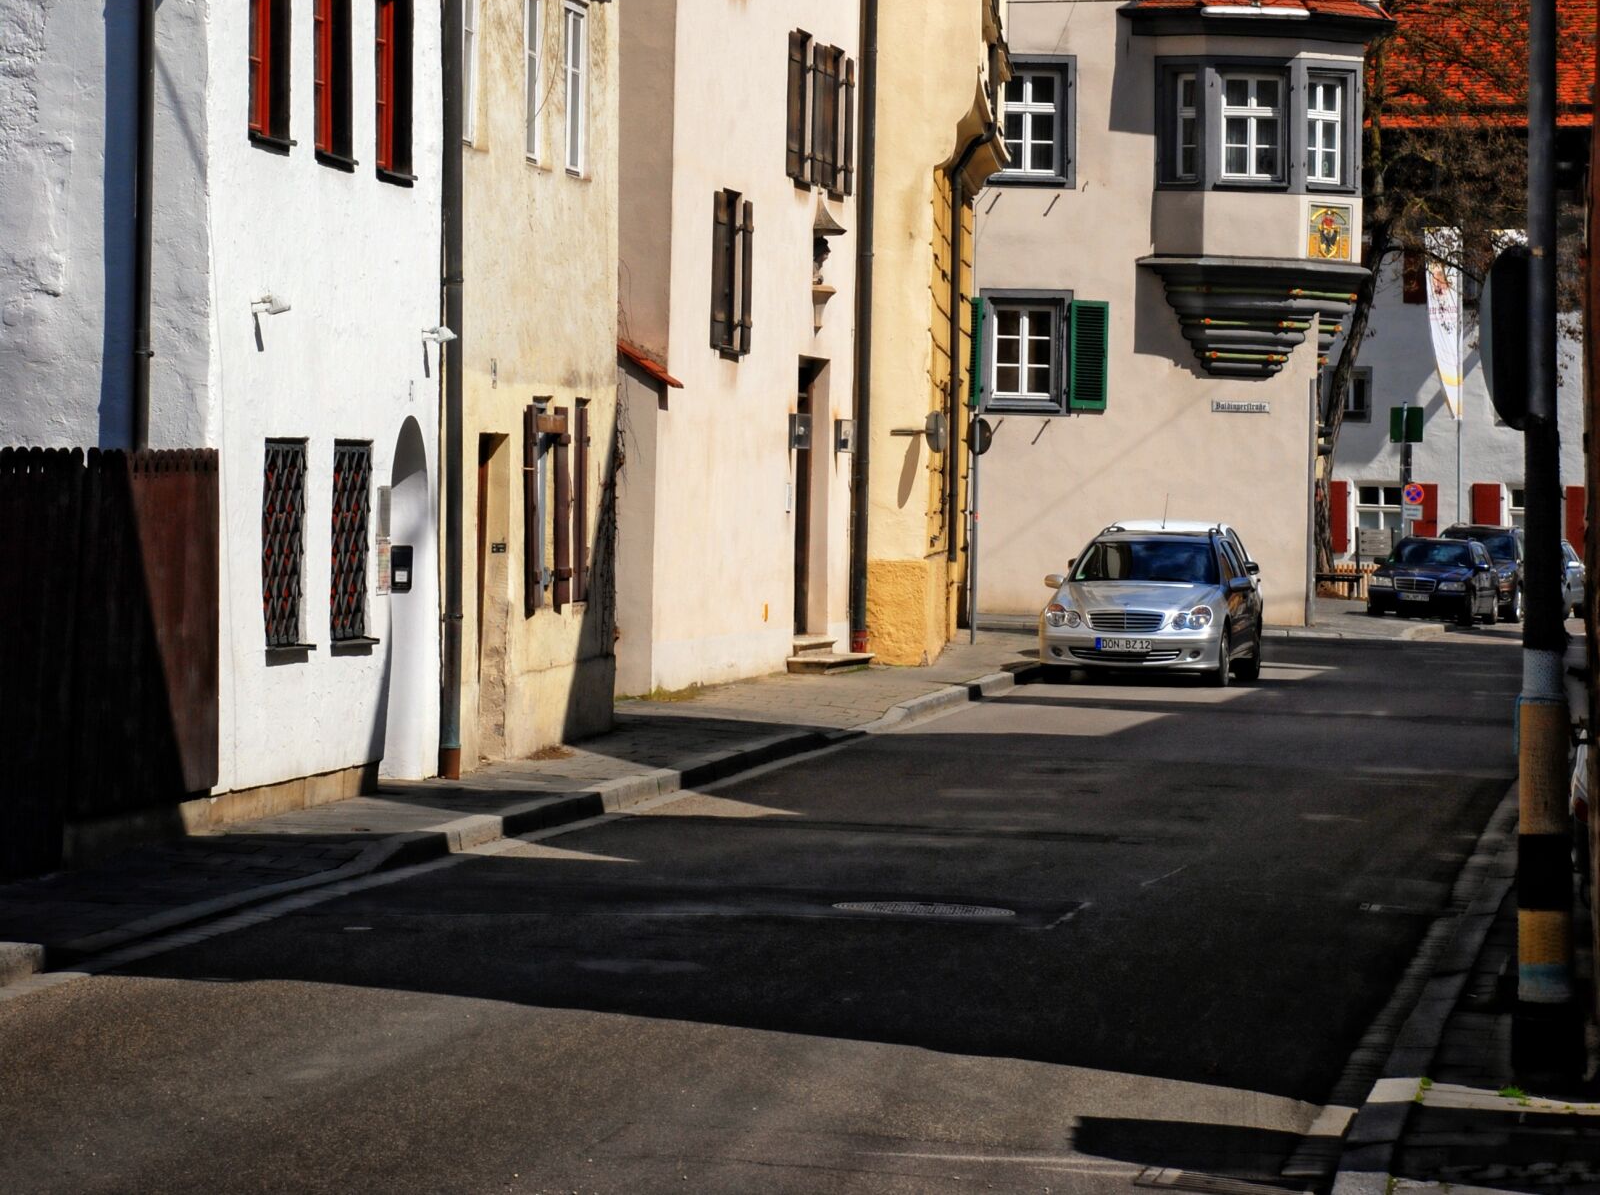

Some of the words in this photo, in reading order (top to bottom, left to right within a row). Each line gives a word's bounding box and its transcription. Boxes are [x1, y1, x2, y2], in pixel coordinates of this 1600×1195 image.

[1102, 639, 1120, 649] DON
[1125, 640, 1138, 650] BZ
[1139, 640, 1151, 650] 12
